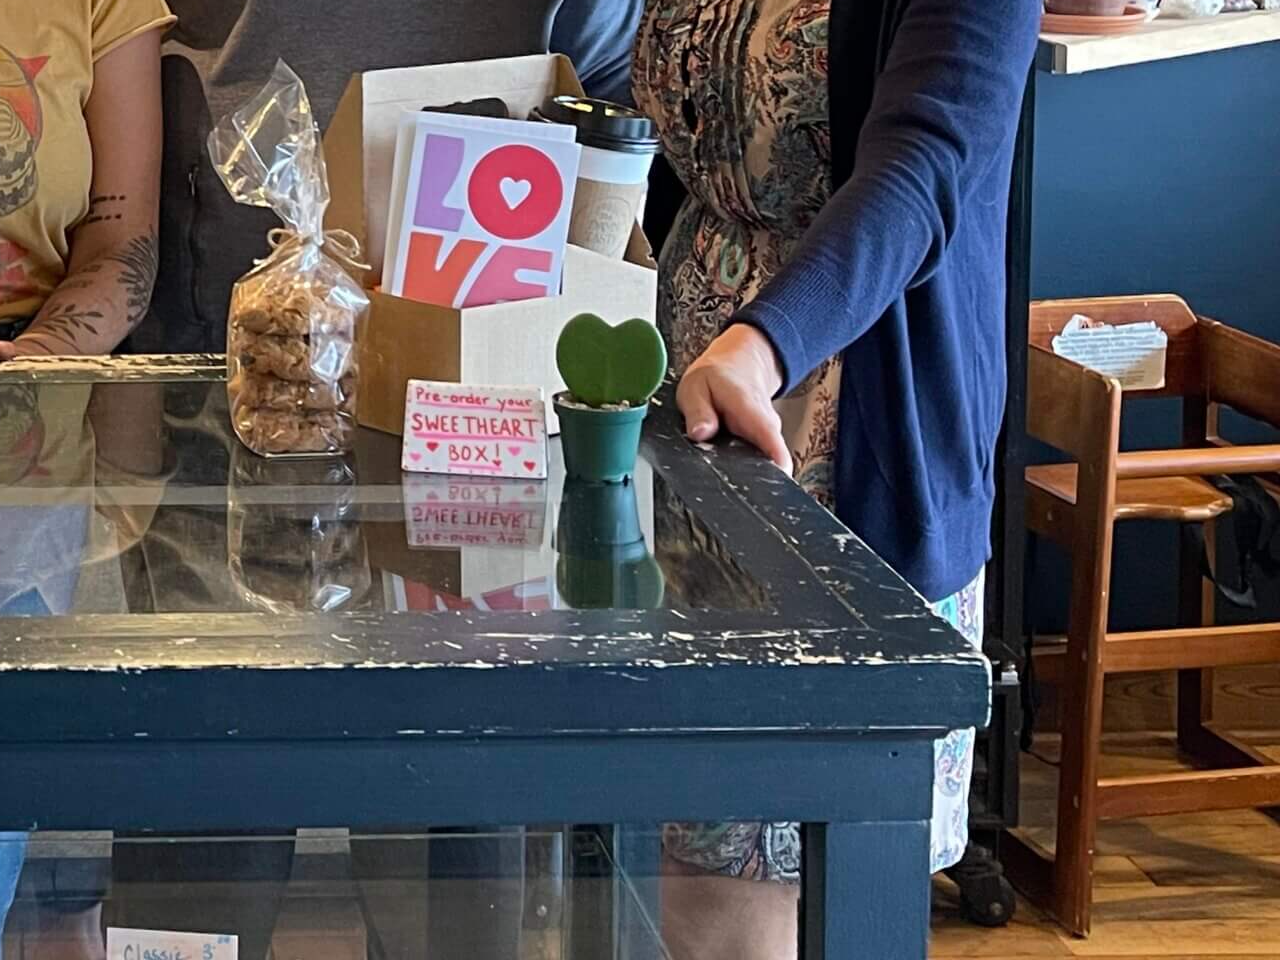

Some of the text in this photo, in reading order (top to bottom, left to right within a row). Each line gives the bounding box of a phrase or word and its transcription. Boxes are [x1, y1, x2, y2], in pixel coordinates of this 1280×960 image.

[415, 386, 533, 413] Pre-order your
[411, 412, 538, 438] SWEETHEART
